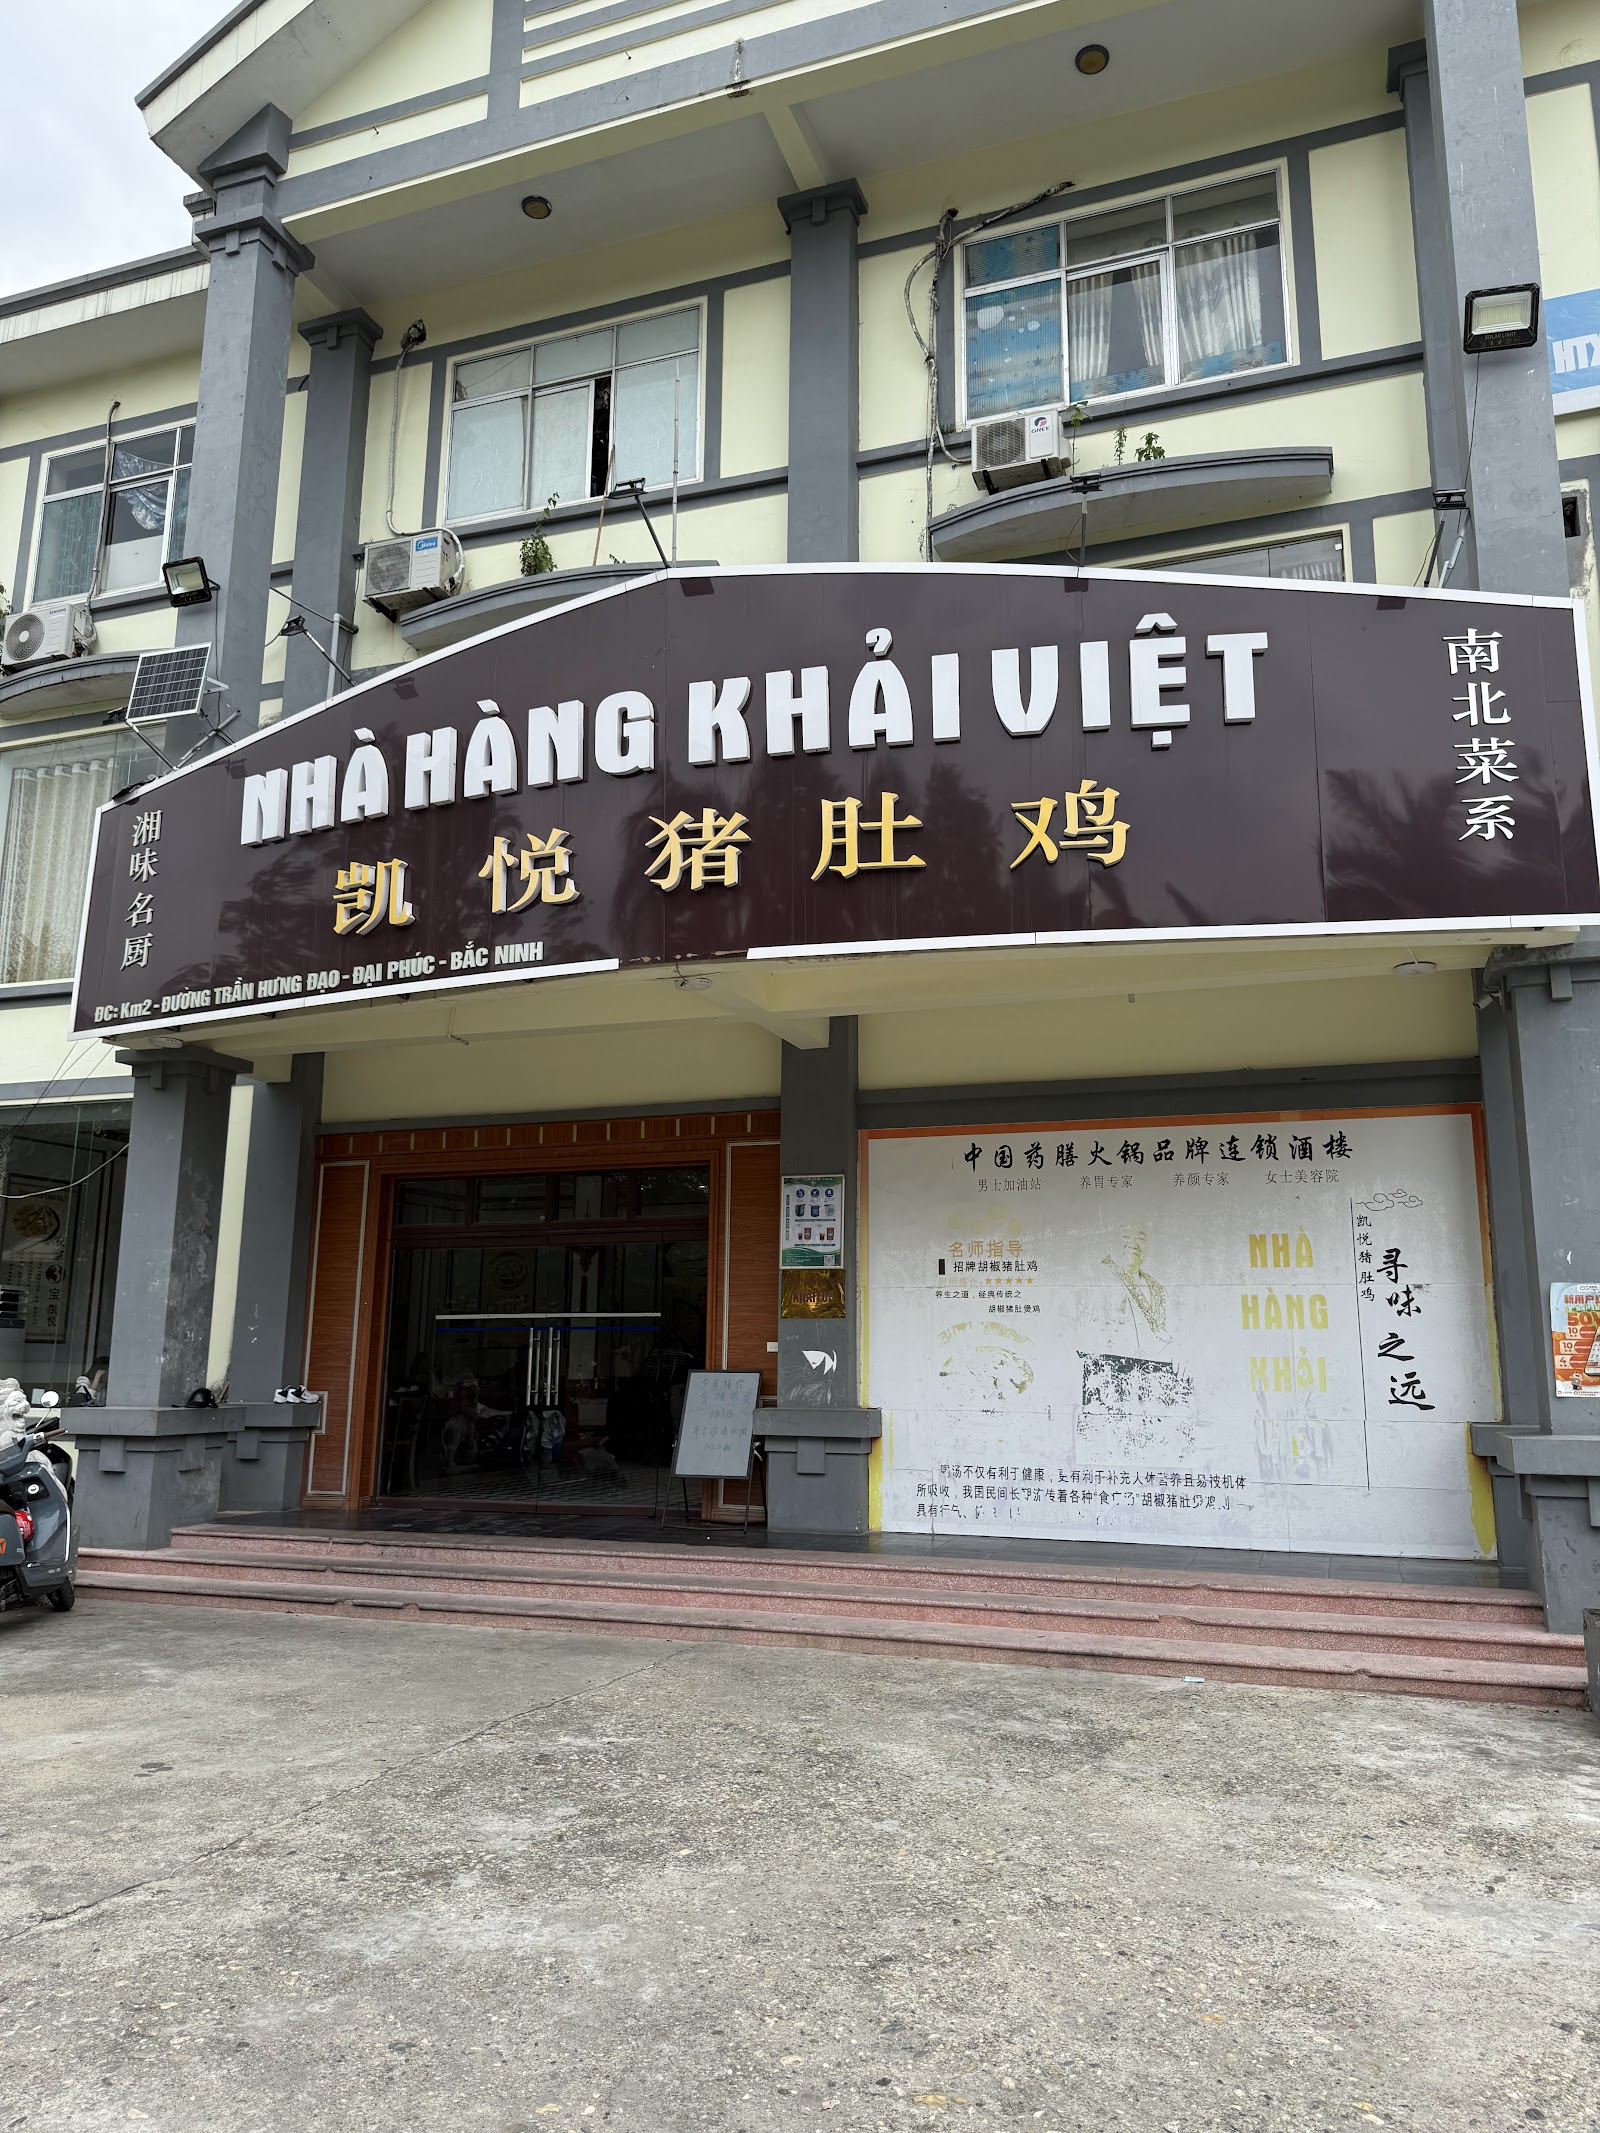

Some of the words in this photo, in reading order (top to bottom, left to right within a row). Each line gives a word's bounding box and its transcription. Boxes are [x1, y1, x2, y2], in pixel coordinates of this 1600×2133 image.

[1031, 426, 1051, 434] GREE
[420, 541, 436, 549] Midea
[240, 727, 390, 847] NHÀ
[404, 690, 656, 811] HÀNG
[688, 627, 961, 766] KHẢI
[991, 612, 1269, 748] VIỆT
[1442, 628, 1520, 841] 南北菜系
[332, 779, 1131, 935] 凯悦猪肚鸡
[120, 809, 163, 971] 湘味名厨
[213, 976, 254, 1005] TRẦN
[257, 975, 303, 999] HƯNG
[306, 969, 341, 994] ĐẠO
[352, 963, 383, 987] ĐẠI
[387, 952, 436, 980] PHÚC
[450, 940, 489, 971] BẮC
[494, 941, 544, 966] NINH
[964, 1130, 1354, 1173] 中国药膳火锅品牌连锁酒楼
[1264, 1168, 1340, 1185] 女士美容院
[948, 1240, 1024, 1259] 名师指导
[953, 1260, 1038, 1273] 招牌胡椒猪肚鸡
[1249, 1226, 1314, 1269] NHÀ
[1356, 1215, 1375, 1302] 凯悦猪肚鸡
[1240, 1287, 1329, 1330] HÀNG
[1376, 1247, 1436, 1411] 寻味之远
